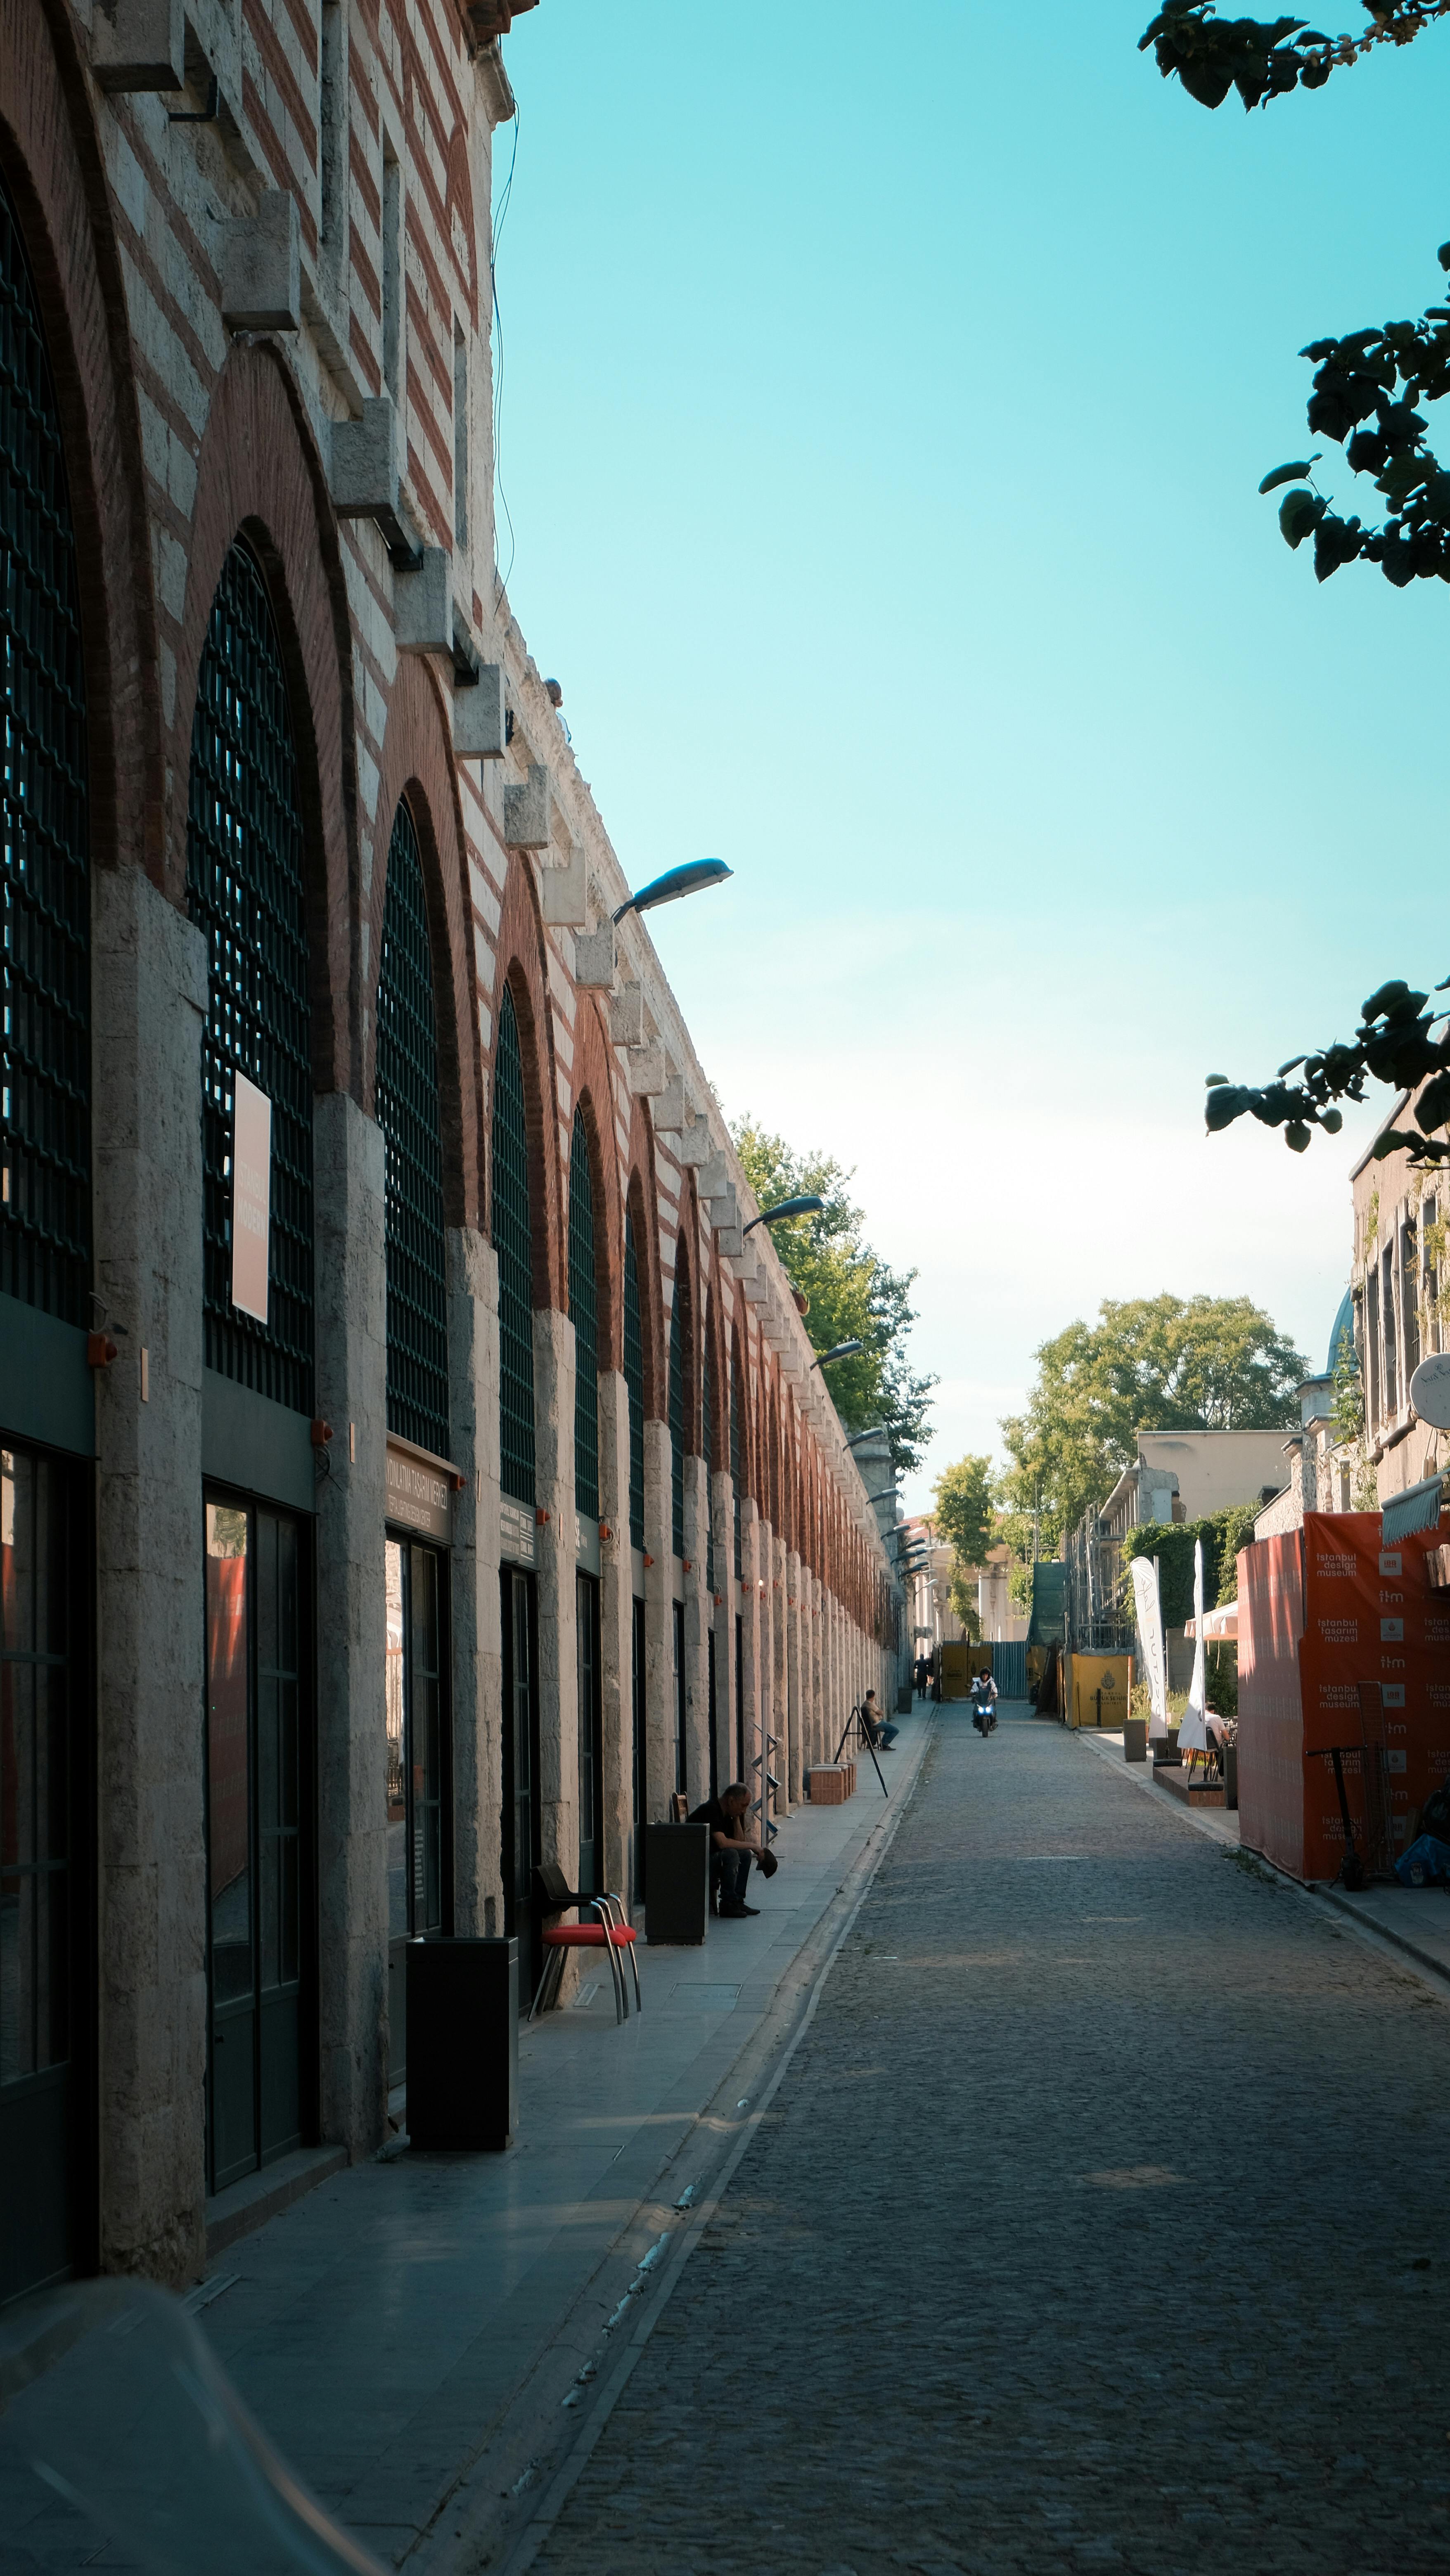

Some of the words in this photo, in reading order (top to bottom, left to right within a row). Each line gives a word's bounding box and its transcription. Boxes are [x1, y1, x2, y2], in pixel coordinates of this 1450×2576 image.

[238, 1195, 265, 1241] MODERN
[1324, 1561, 1356, 1570] design
[1379, 1590, 1403, 1602] itm
[1381, 1656, 1405, 1668] itm
[1327, 1693, 1359, 1701] design
